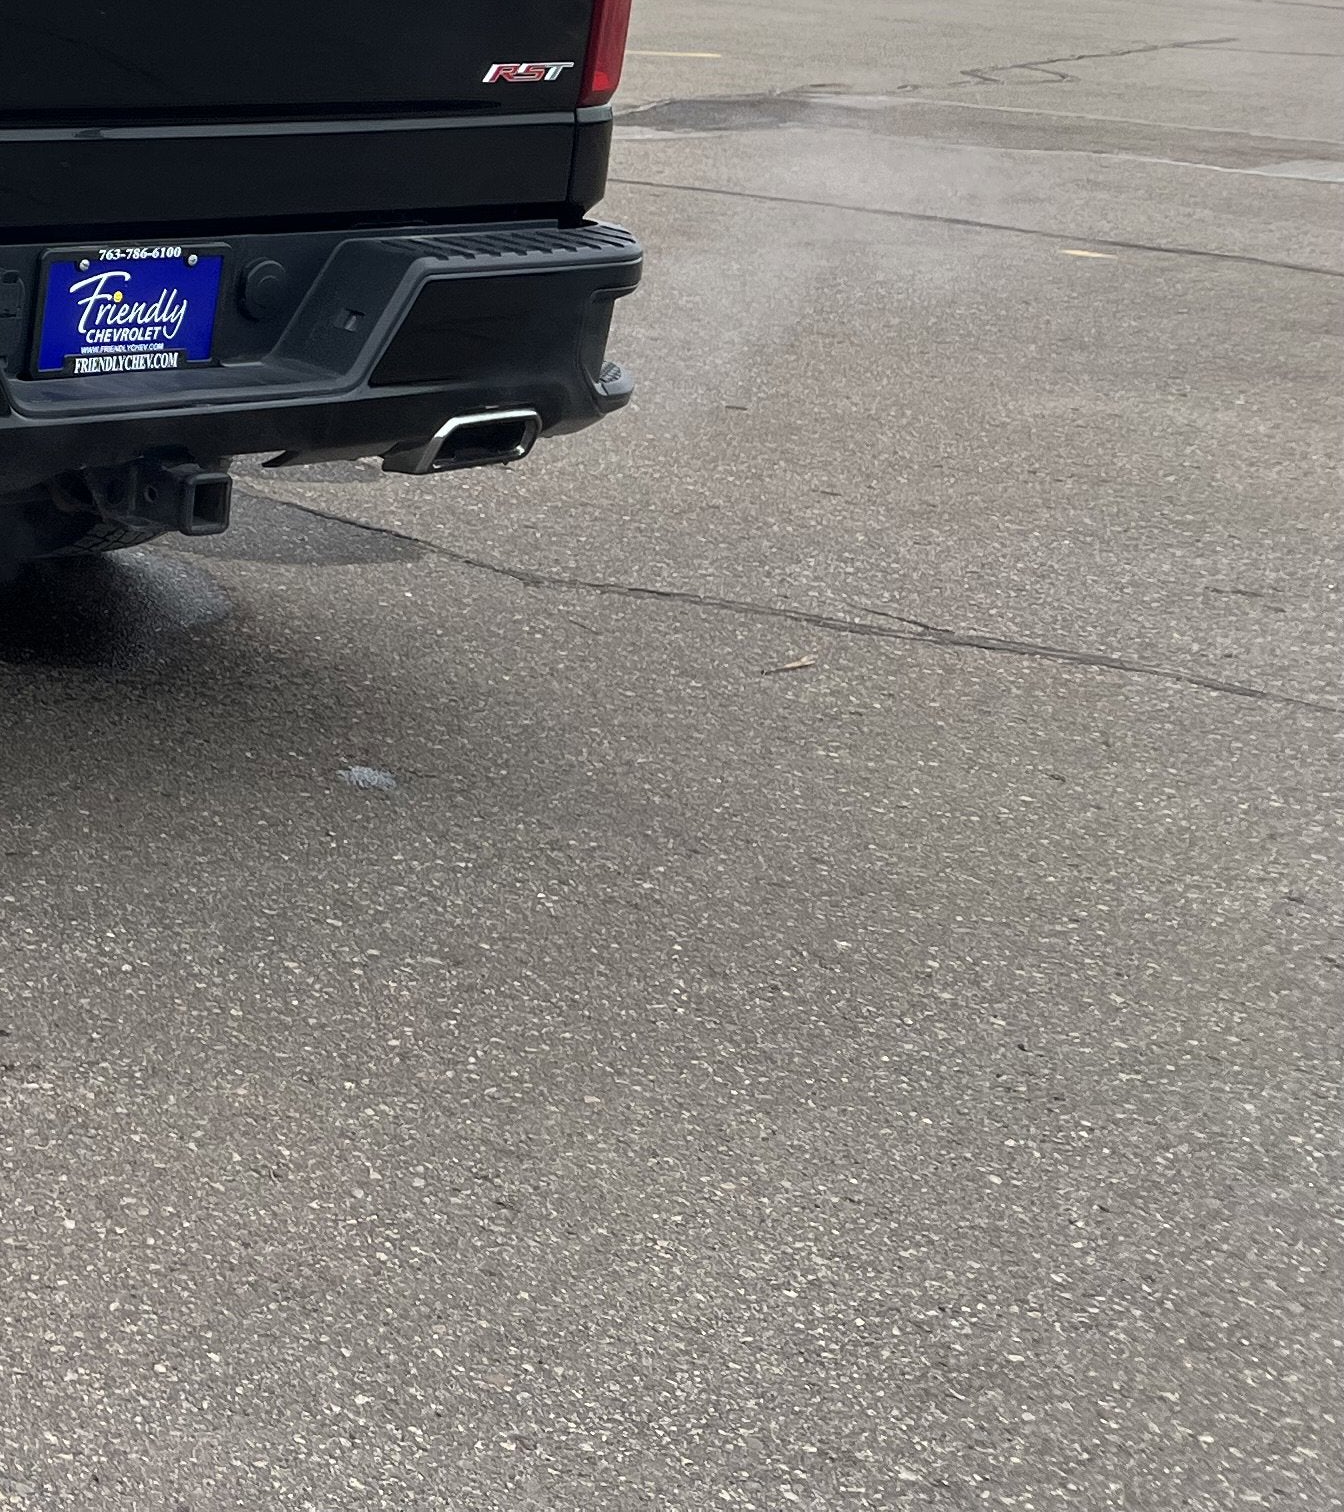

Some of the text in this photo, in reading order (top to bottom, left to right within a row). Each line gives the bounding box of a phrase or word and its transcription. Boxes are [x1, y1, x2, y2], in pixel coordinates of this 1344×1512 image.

[482, 61, 575, 83] RST
[98, 246, 181, 260] 763-786-6100
[69, 270, 188, 340] Friendly
[85, 326, 163, 343] CHEVROLET
[80, 343, 165, 354] WWW.FRIENDLYCHEV.COM
[74, 352, 178, 373] FRIENDLYCHEV.COM
